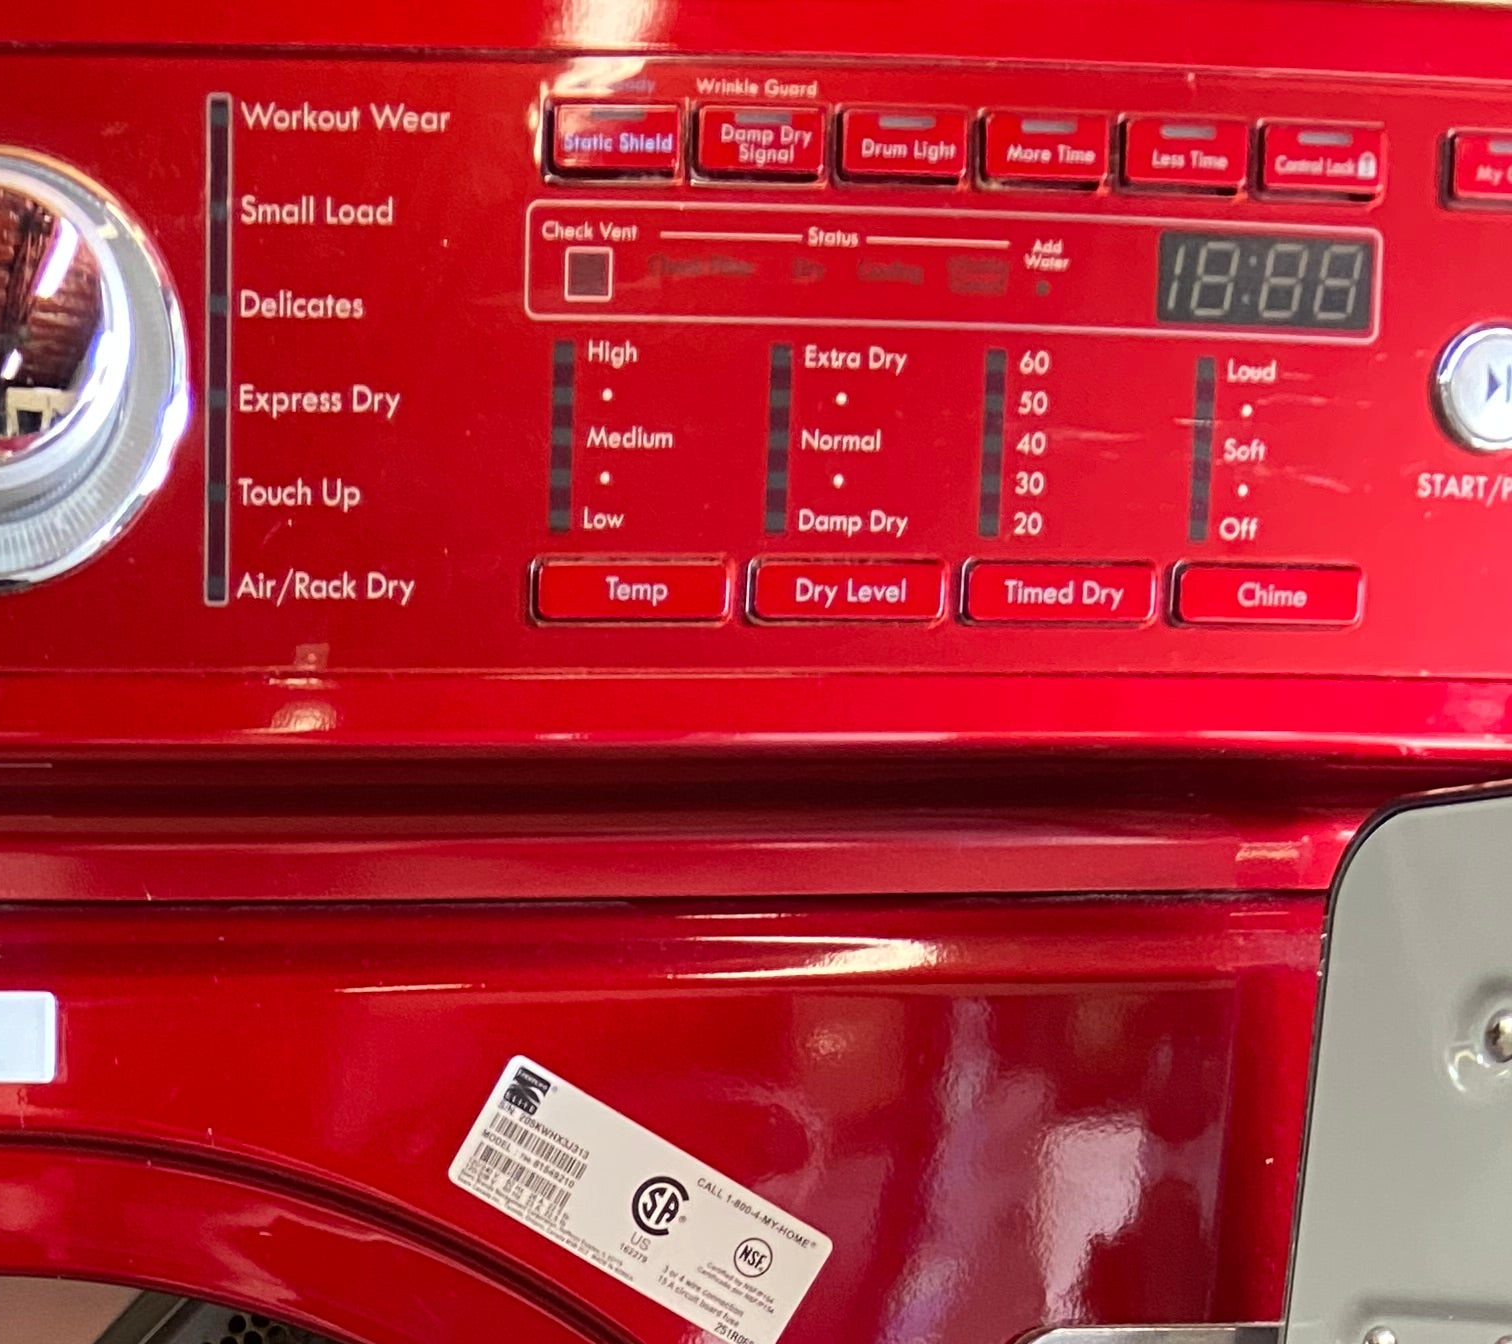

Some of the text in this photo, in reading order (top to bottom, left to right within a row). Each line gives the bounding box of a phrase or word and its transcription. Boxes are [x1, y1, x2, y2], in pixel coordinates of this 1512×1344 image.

[696, 78, 818, 97] Wrinkle Guard
[240, 102, 450, 132] Workout Wear
[564, 133, 674, 153] Static Shield
[721, 124, 812, 146] Damp Dry
[739, 144, 794, 166] Signal
[862, 138, 956, 162] Drum Light
[1006, 144, 1095, 164] More Time
[1151, 149, 1229, 171] Less Time
[1274, 155, 1355, 176] Control Lock
[1476, 165, 1503, 185] My
[240, 196, 394, 225] Small Load
[541, 221, 638, 241] Check Vent
[808, 226, 859, 248] Status
[1032, 239, 1063, 254] Add
[1024, 253, 1069, 271] Water
[240, 289, 364, 319] Delicates
[588, 341, 637, 369] High
[804, 345, 907, 375] Extra Dry
[1020, 351, 1050, 374] 60
[1227, 359, 1276, 383] Loud
[239, 384, 400, 418] Express Dry
[1018, 391, 1049, 415] 50
[587, 427, 674, 450] Medium
[801, 430, 881, 452] Normal
[1017, 432, 1047, 455] 40
[1223, 439, 1266, 462] Soft
[1015, 472, 1045, 495] 30
[238, 478, 361, 513] Touch Up
[583, 508, 623, 530] Low
[798, 509, 908, 538] Damp Dry
[1013, 512, 1043, 536] 20
[1220, 517, 1258, 541] Off
[236, 568, 415, 607] Air/Rack Dry
[606, 577, 669, 607] Temp
[795, 579, 906, 607] Dry Level
[1005, 579, 1124, 611] Timed Dry
[1237, 582, 1307, 608] Chime
[482, 1129, 511, 1152] MODEL
[697, 1177, 810, 1248] CALL 1-800-4-MY-HOME
[630, 1231, 651, 1251] US
[662, 1264, 669, 1273] 3
[739, 1245, 768, 1271] NSF
